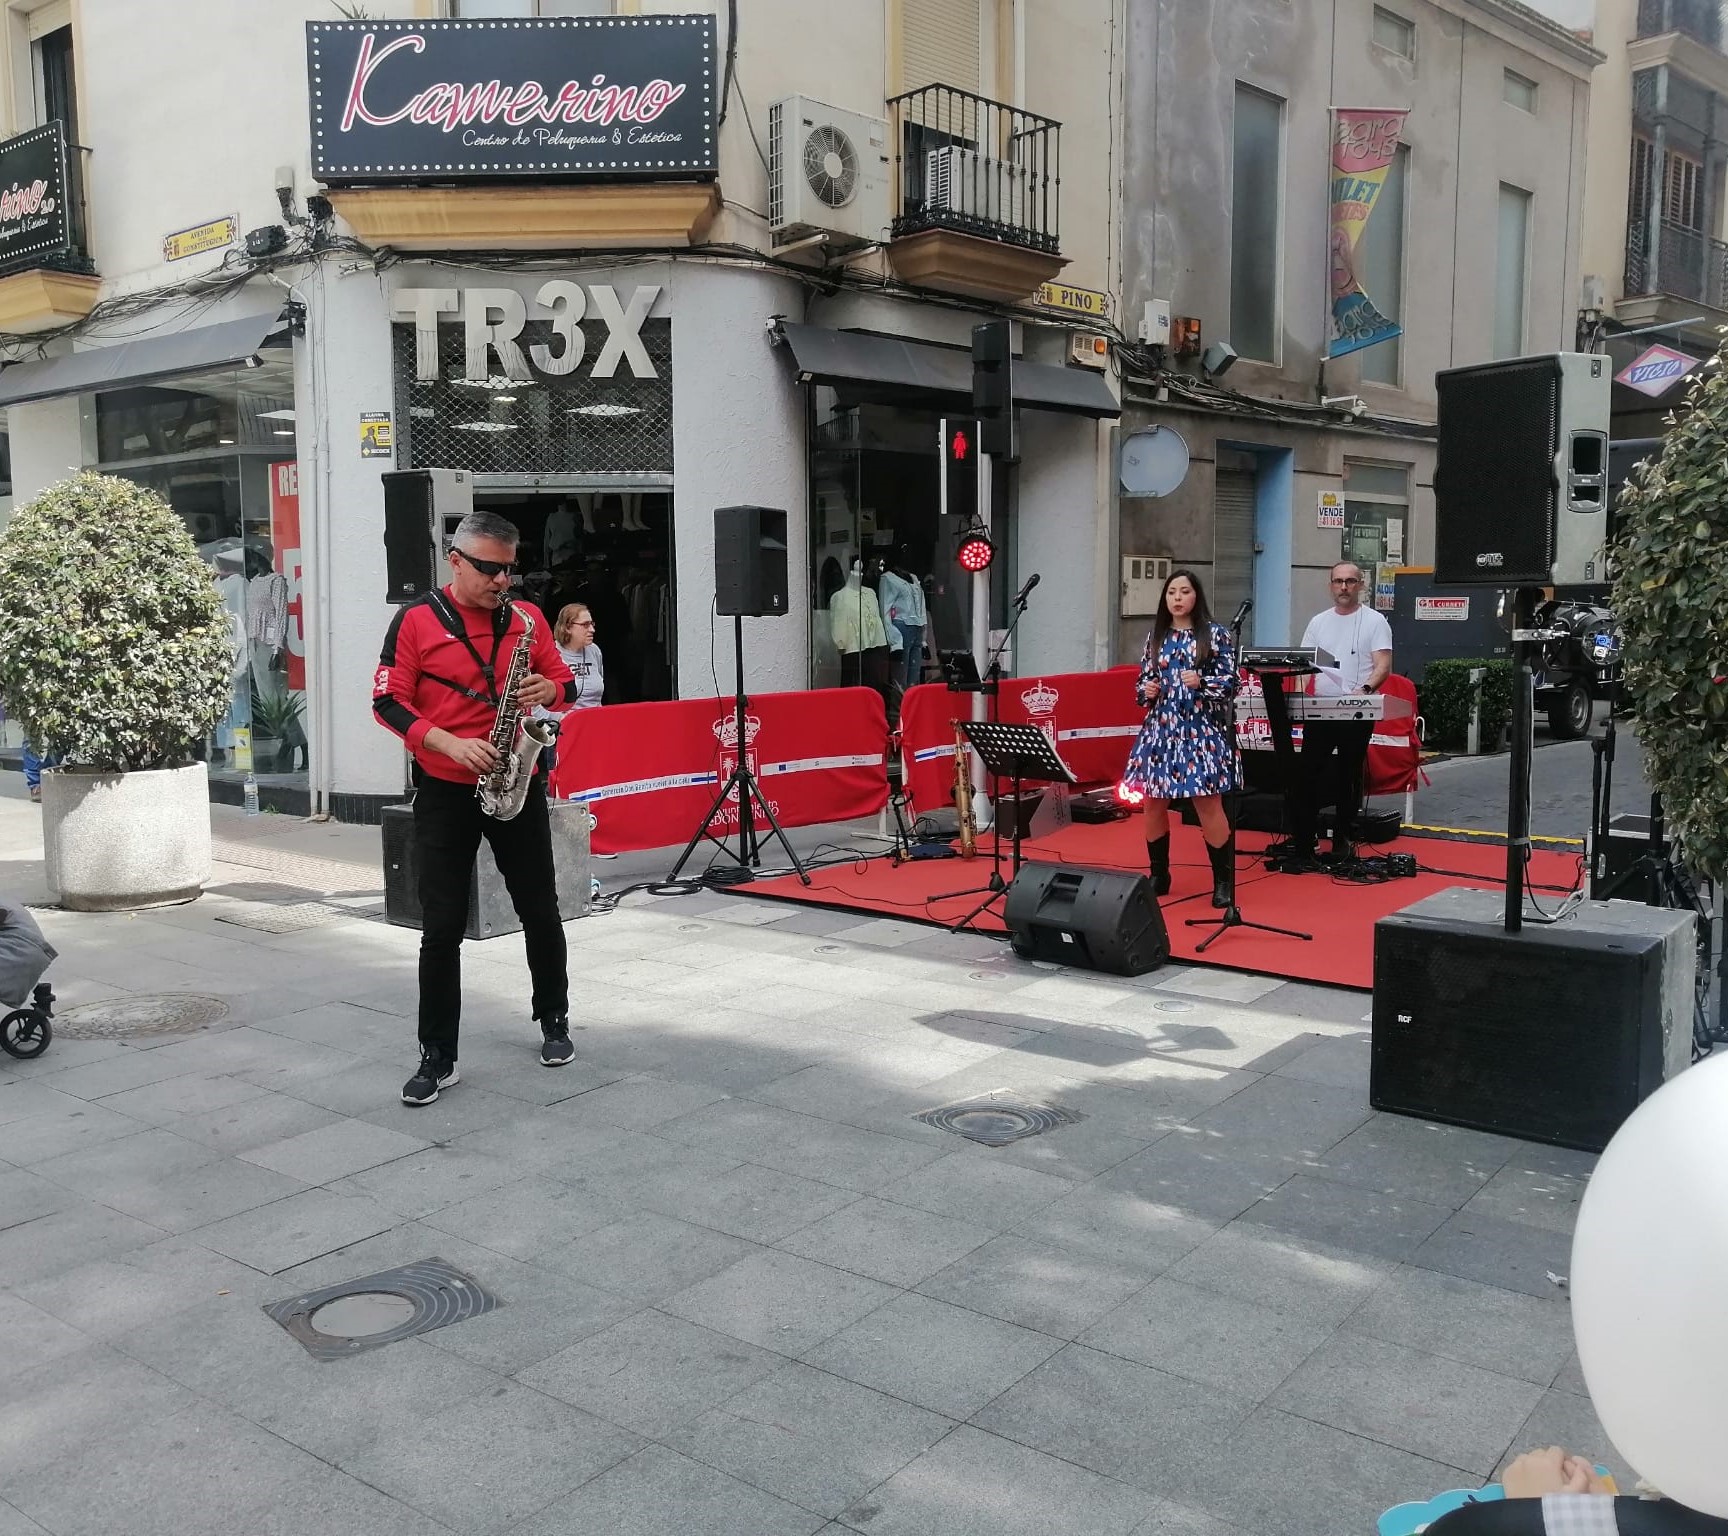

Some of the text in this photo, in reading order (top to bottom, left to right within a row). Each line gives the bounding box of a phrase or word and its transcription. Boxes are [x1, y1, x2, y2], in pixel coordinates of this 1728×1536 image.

[340, 33, 686, 132] Kamerino
[462, 129, 510, 147] Centro
[512, 129, 530, 146] de
[612, 128, 622, 145] &
[191, 226, 215, 239] AVENIDA
[1061, 290, 1092, 309] PINO
[395, 280, 662, 381] TR3X
[1319, 507, 1343, 517] VENDE
[1398, 1014, 1412, 1023] RCF
